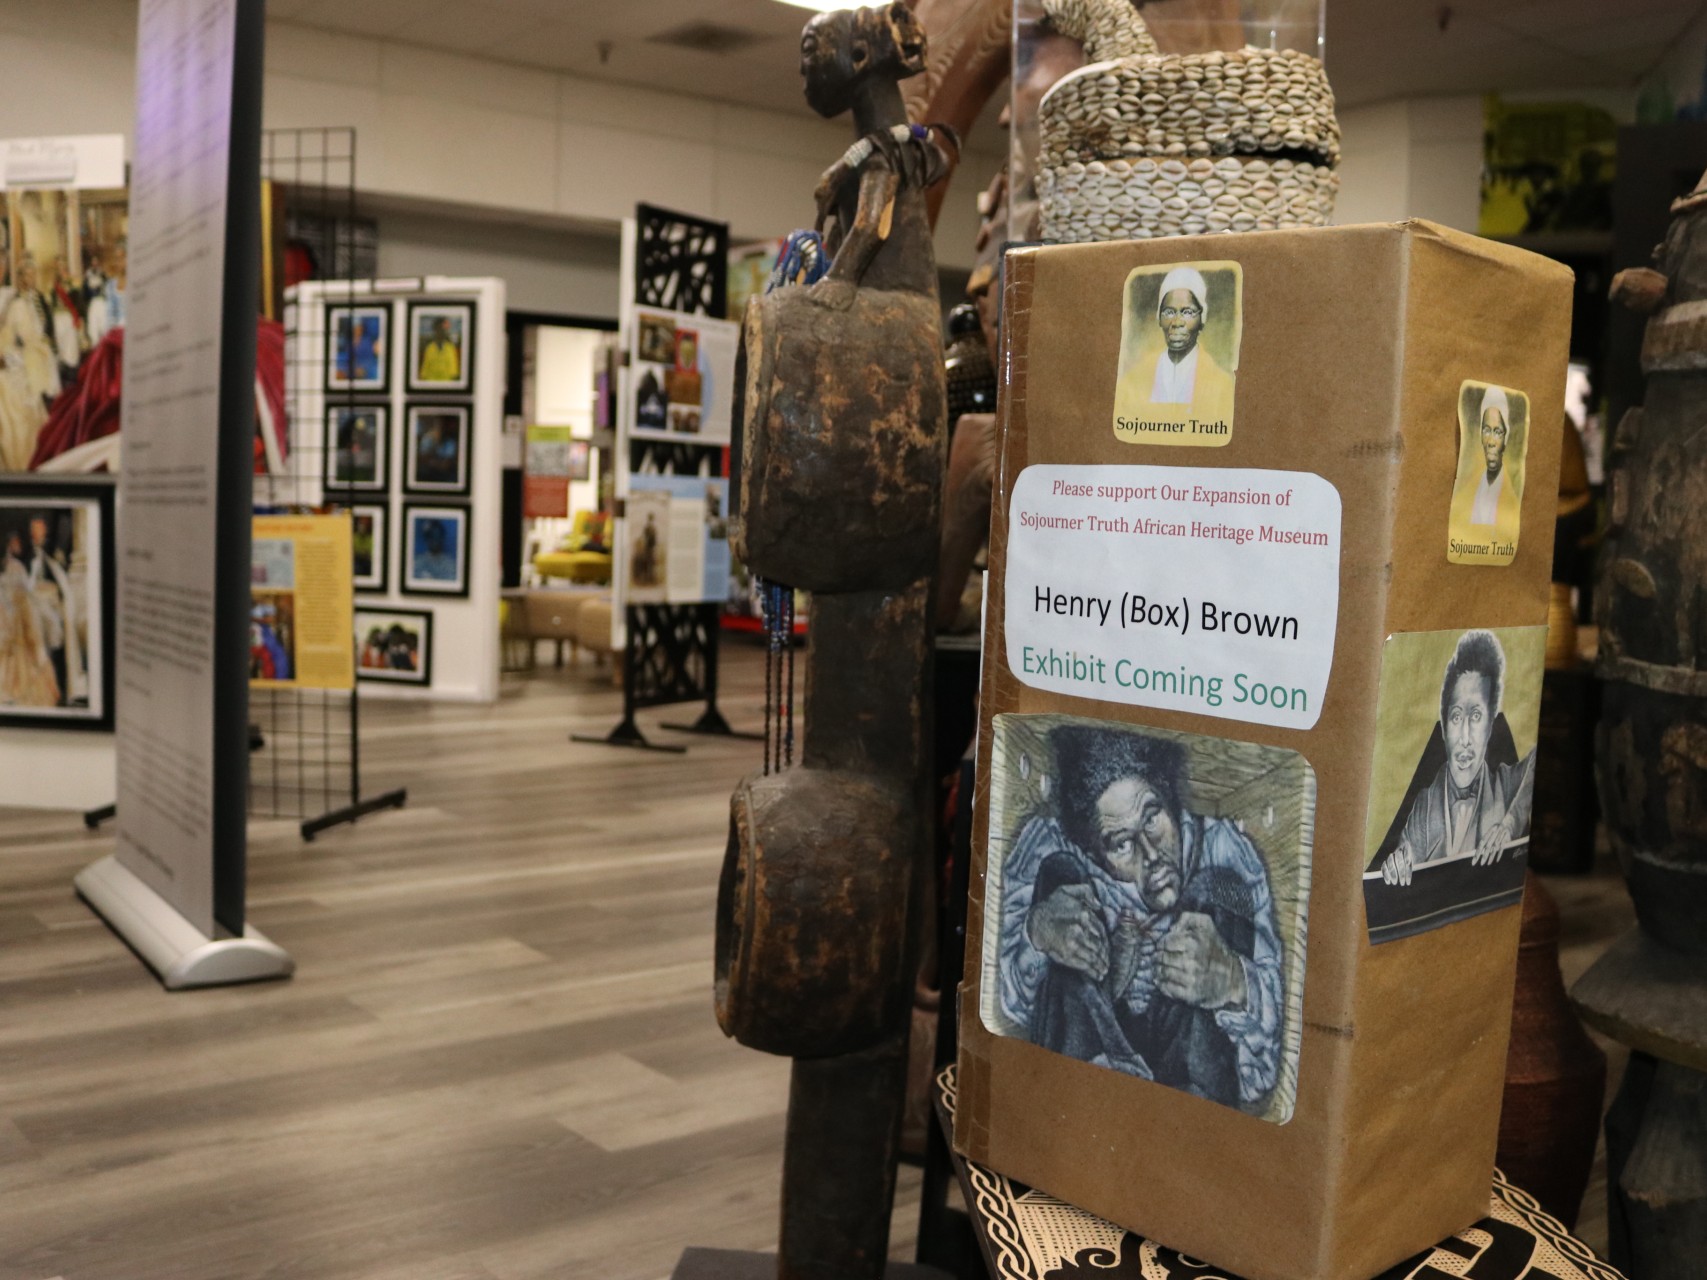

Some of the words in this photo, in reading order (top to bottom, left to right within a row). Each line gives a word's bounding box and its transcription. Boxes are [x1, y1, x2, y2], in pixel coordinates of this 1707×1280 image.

[1116, 417, 1185, 435] Sojourner
[1189, 419, 1228, 434] Truth
[1052, 480, 1093, 497] Please
[1097, 485, 1157, 502] support
[1161, 484, 1189, 501] Our
[1192, 485, 1271, 507] Expansion
[1275, 489, 1292, 506] of
[1020, 511, 1084, 530] Sojourner
[1087, 516, 1129, 533] Truth
[1133, 518, 1186, 536] African
[1190, 521, 1254, 545] Heritage
[1258, 525, 1329, 546] Museum
[1449, 538, 1489, 557] Sojourner
[1491, 541, 1514, 556] Truth
[1034, 585, 1111, 626] Henry
[1120, 591, 1190, 635] (Box)
[1201, 602, 1299, 640] Brown
[1022, 646, 1106, 684] Exhibit
[1114, 659, 1223, 706] Coming
[1232, 673, 1308, 712] Soon
